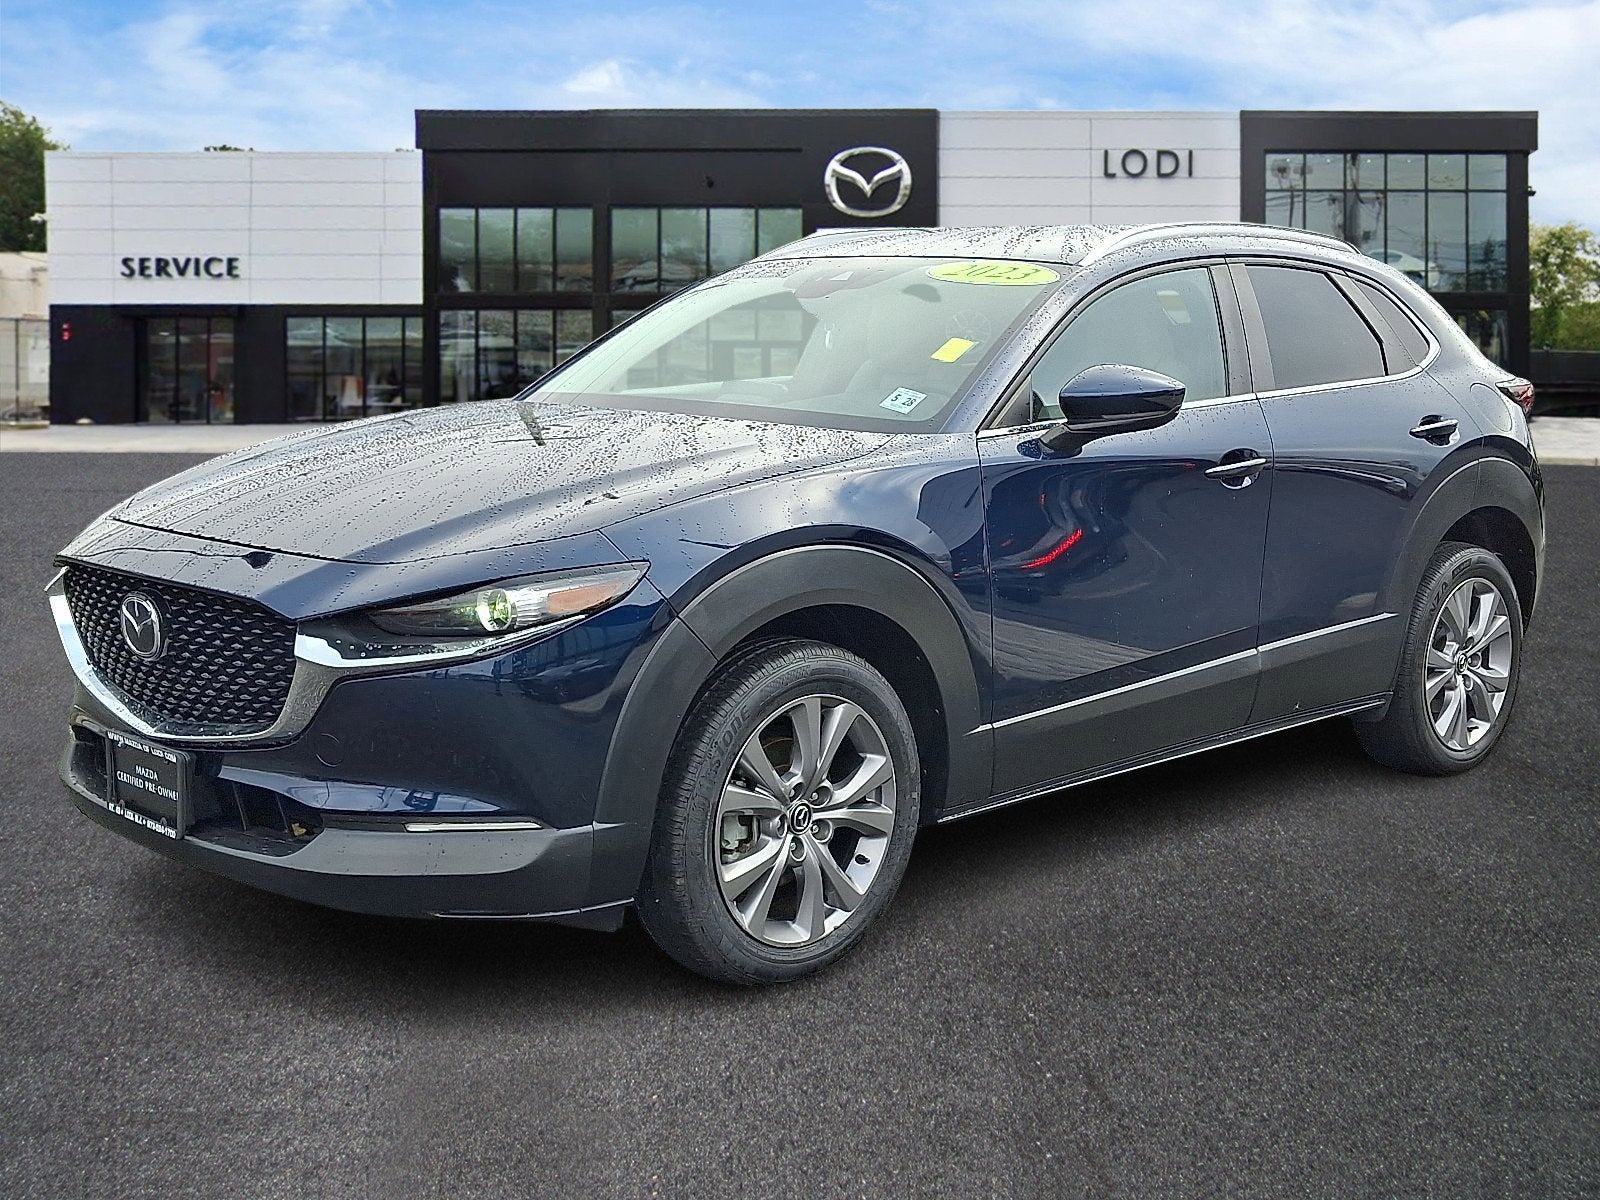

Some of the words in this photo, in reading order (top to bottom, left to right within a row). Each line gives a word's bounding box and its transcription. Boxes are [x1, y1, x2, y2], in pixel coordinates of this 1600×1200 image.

[1104, 149, 1193, 178] LODI
[120, 257, 240, 278] SERVICE
[942, 264, 1041, 280] 2023
[116, 770, 143, 789] CERTIFIED
[135, 765, 159, 781] MAZDA
